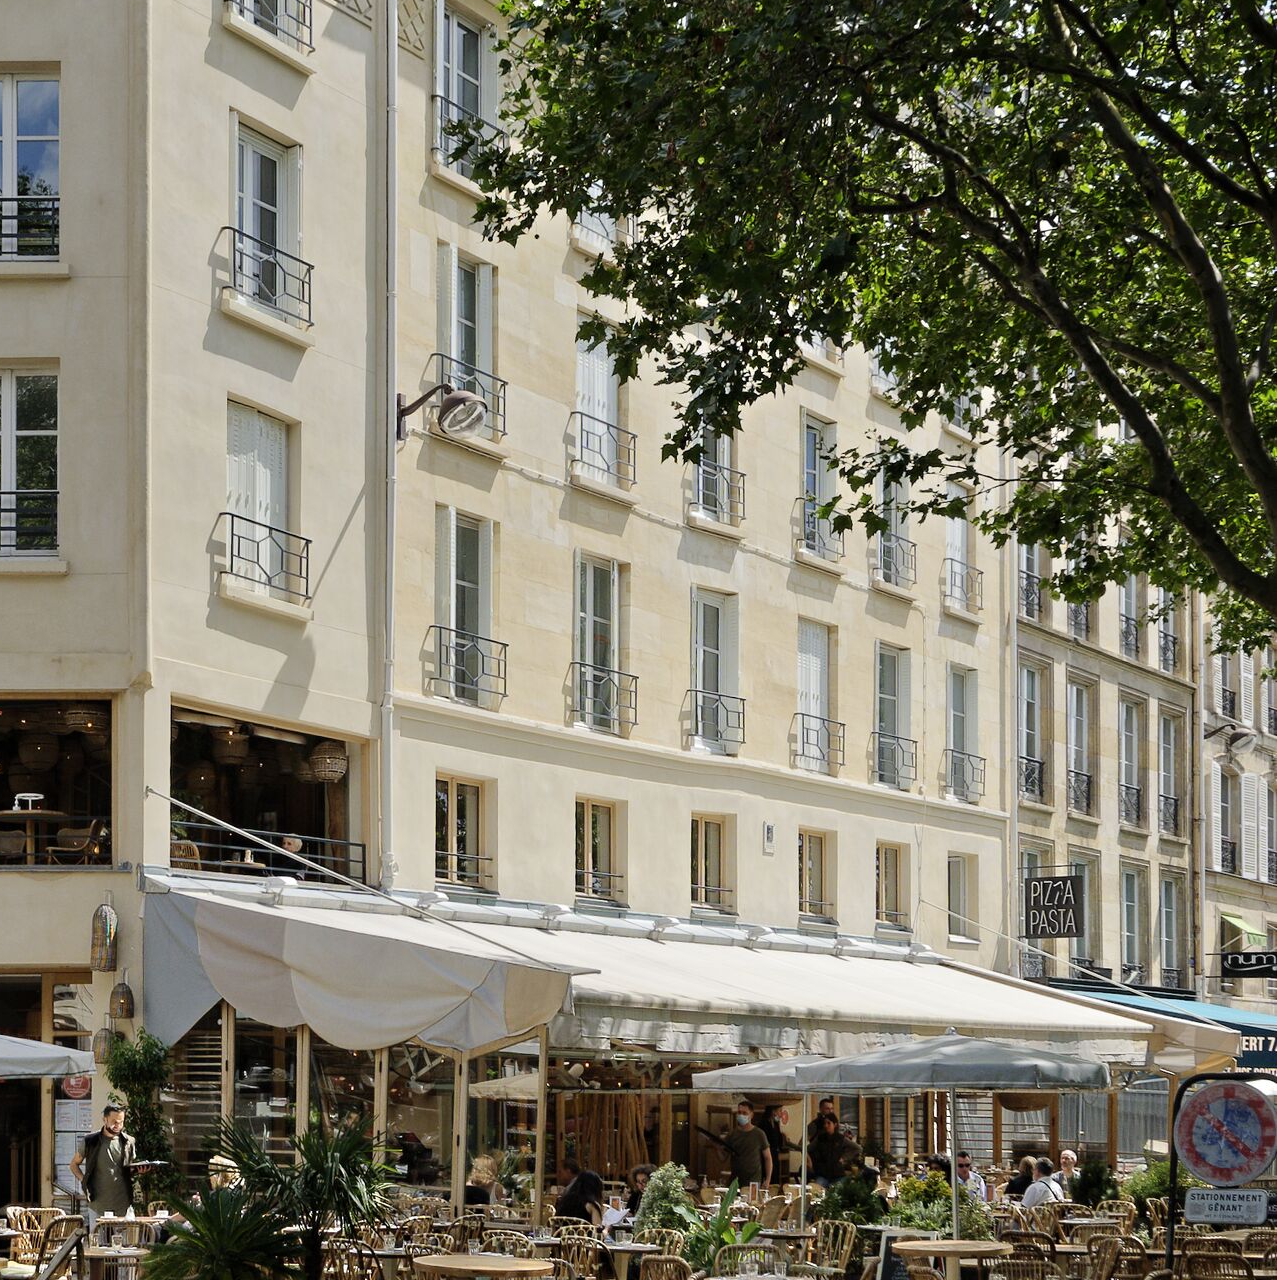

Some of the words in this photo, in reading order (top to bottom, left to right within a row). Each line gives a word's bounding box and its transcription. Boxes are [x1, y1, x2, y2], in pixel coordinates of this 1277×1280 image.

[1031, 880, 1075, 906] PIZZA
[1030, 908, 1077, 935] PASTA
[1240, 1036, 1265, 1051] ERT
[1190, 1193, 1263, 1202] STATIONNEMENT
[1208, 1202, 1243, 1212] GÊNANT
